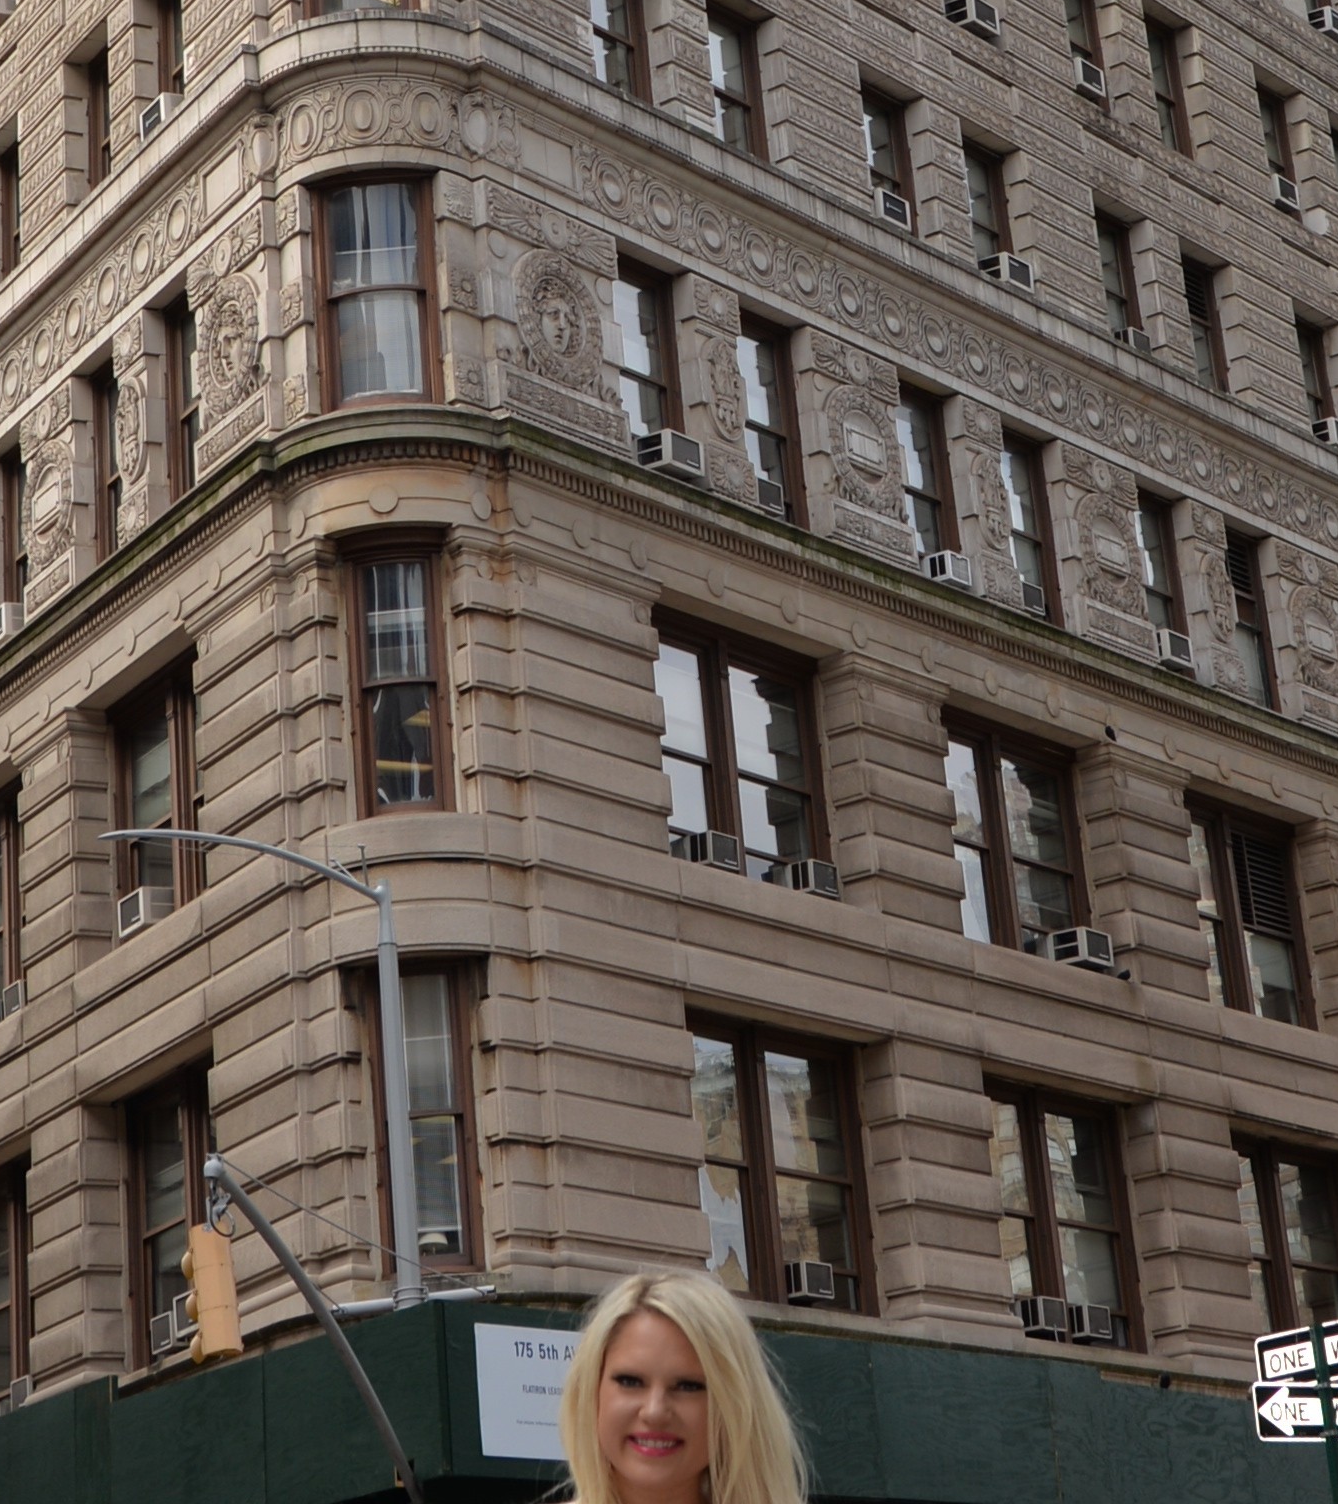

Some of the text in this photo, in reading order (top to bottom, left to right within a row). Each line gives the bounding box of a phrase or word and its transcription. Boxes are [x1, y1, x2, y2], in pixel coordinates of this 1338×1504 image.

[514, 1341, 534, 1359] 175
[538, 1343, 558, 1360] 5th
[1270, 1347, 1309, 1373] ONE
[1270, 1402, 1310, 1421] ONE
